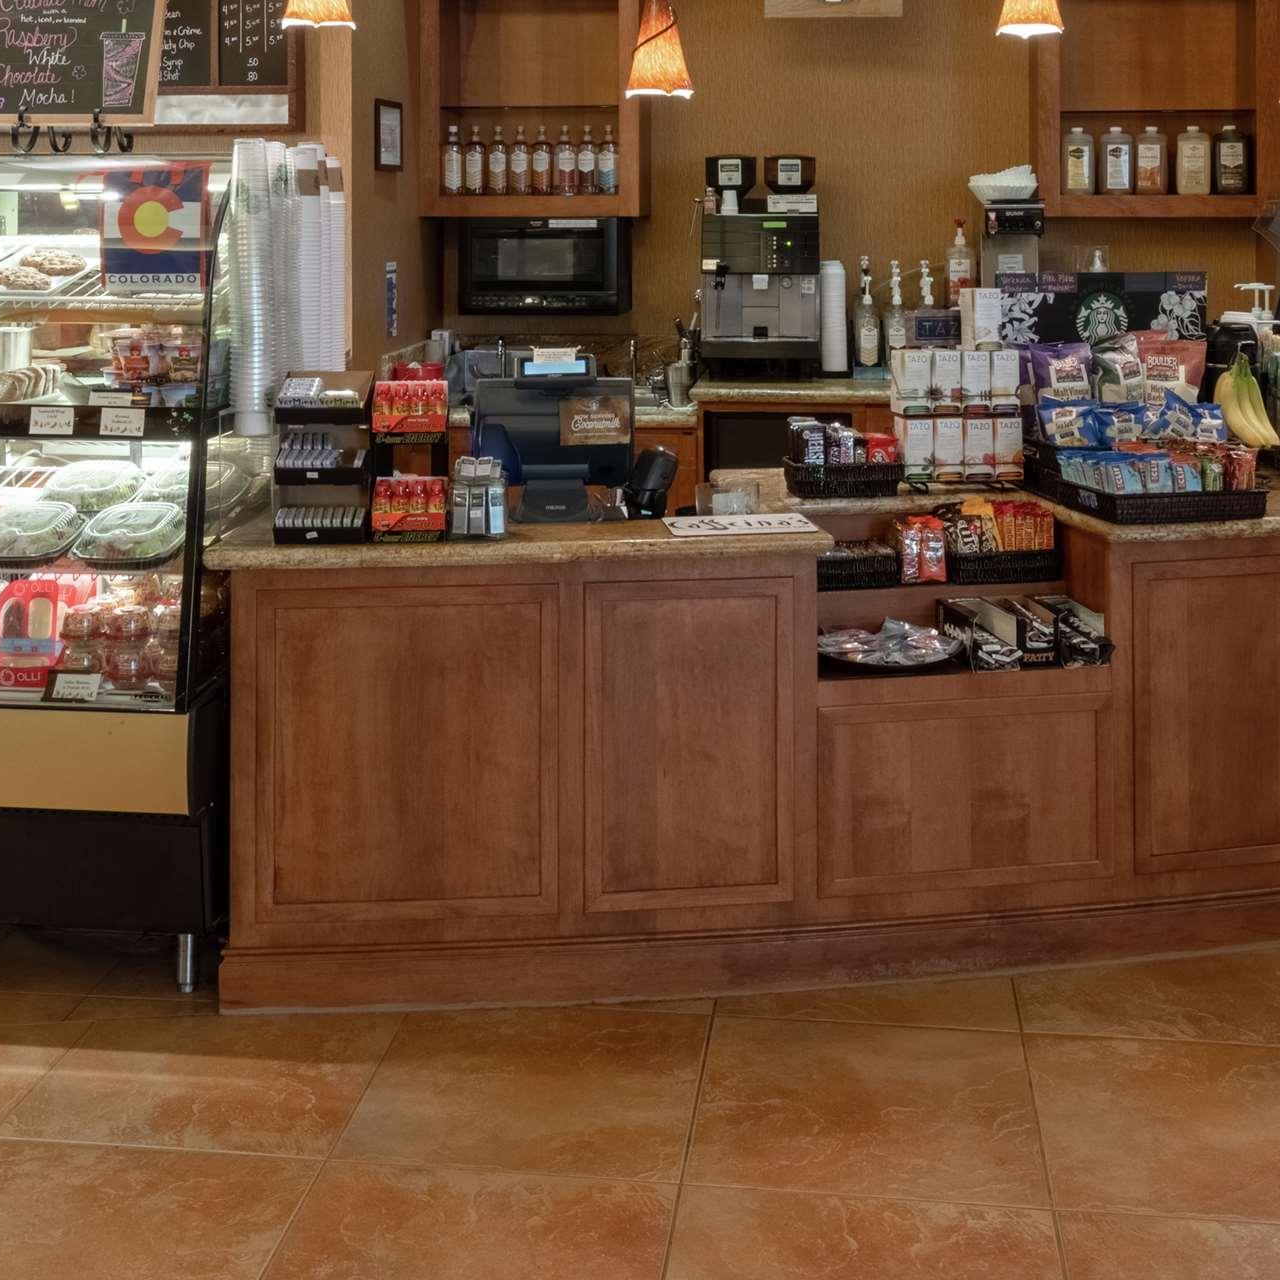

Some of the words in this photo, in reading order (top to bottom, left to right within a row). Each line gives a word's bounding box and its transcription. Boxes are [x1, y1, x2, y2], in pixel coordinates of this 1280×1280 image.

[23, 47, 71, 68] White
[108, 274, 198, 284] COLORADO
[922, 321, 960, 336] TAZ
[967, 354, 988, 362] TAZO
[996, 353, 1017, 362] TAZO
[1147, 355, 1178, 368] BOULDER
[970, 422, 991, 431] TAZO
[1000, 421, 1020, 429] TAZO
[30, 583, 55, 593] OLLI
[16, 671, 41, 681] OLLI
